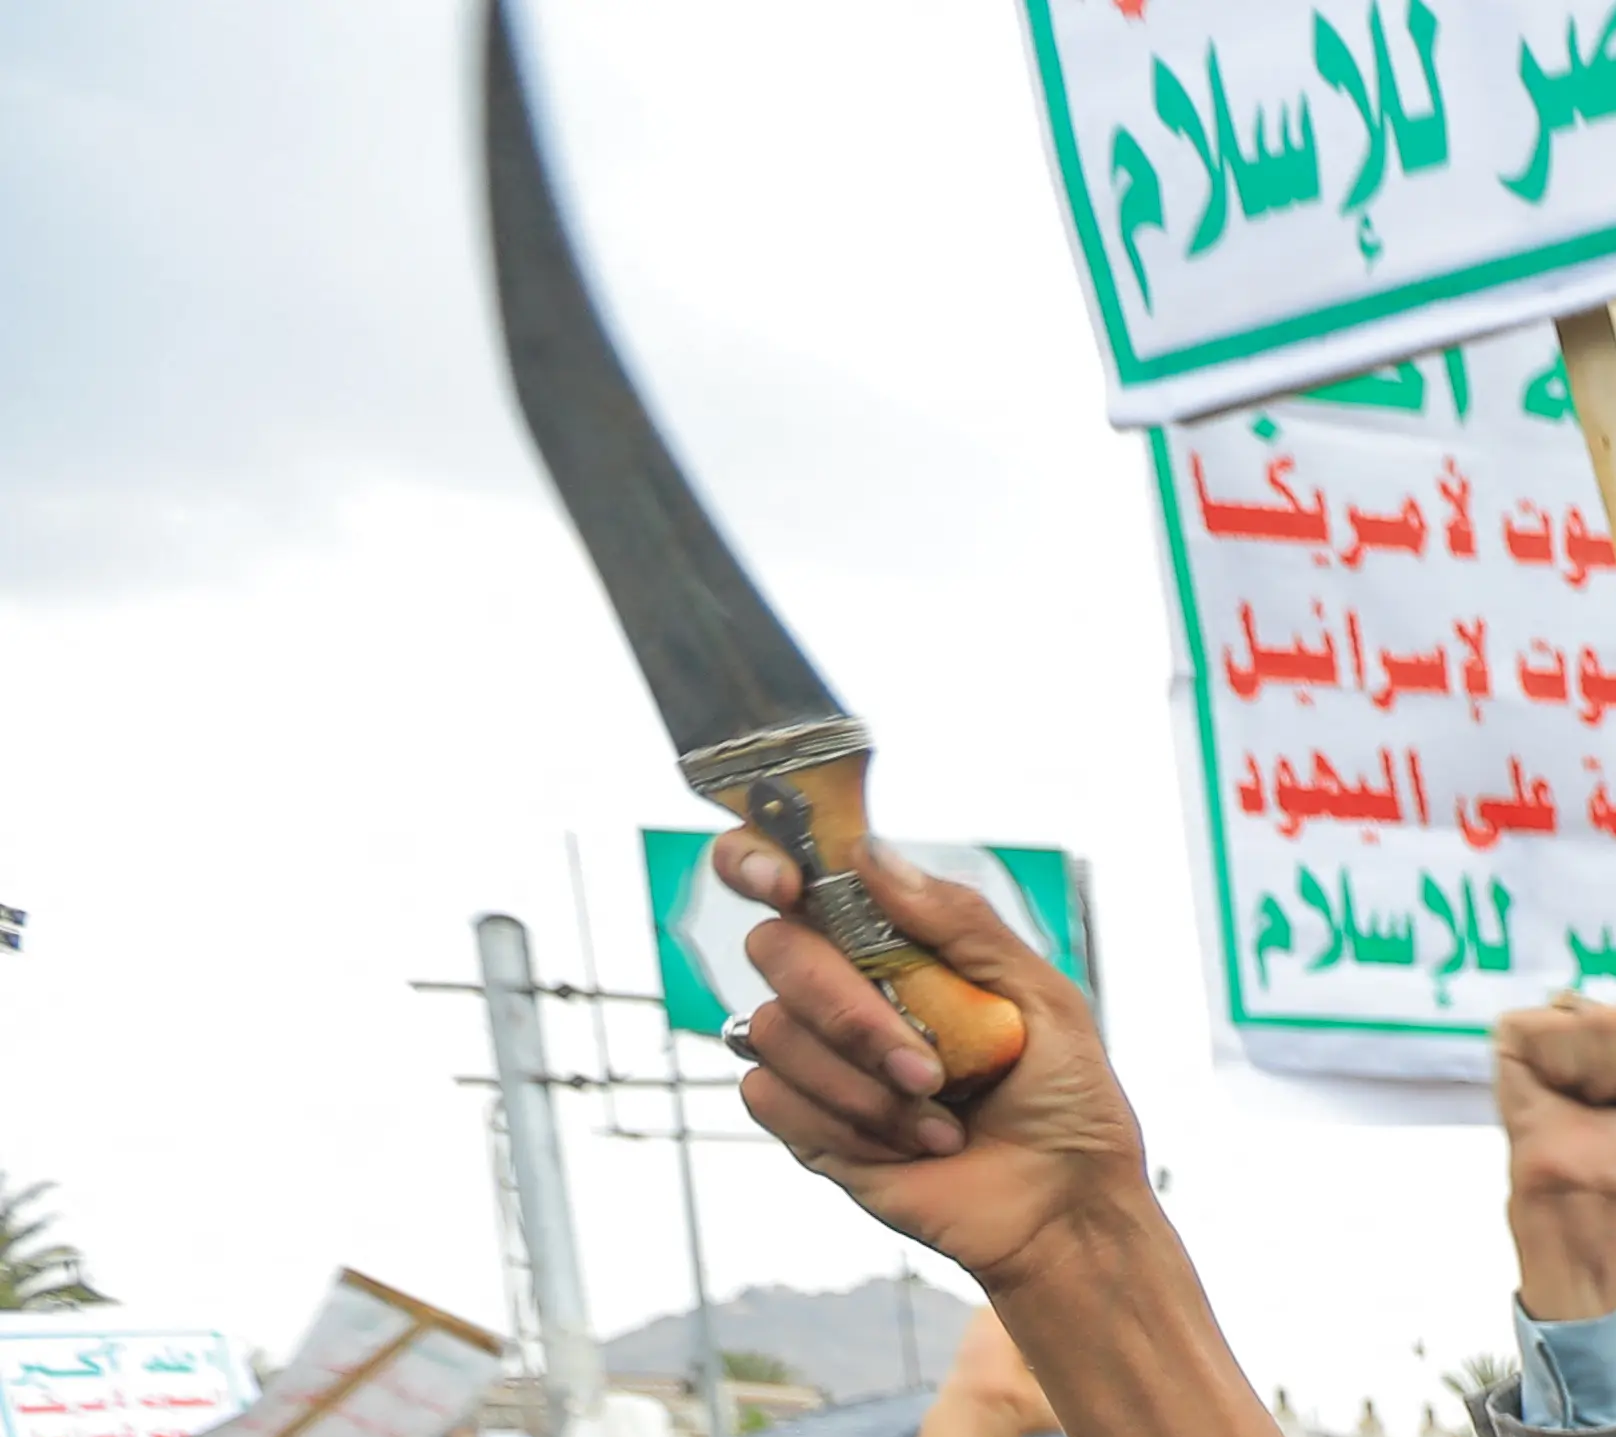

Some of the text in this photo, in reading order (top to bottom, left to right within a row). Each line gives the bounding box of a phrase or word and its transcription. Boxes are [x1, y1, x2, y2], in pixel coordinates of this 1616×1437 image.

[1108, 0, 1450, 315] للإسلام
[1190, 452, 1478, 571] لأمريكا
[1222, 599, 1493, 724] لإسرائيل
[1236, 746, 1430, 845] اليهود
[1456, 755, 1557, 850] على
[1255, 863, 1513, 1008] للإسلام
